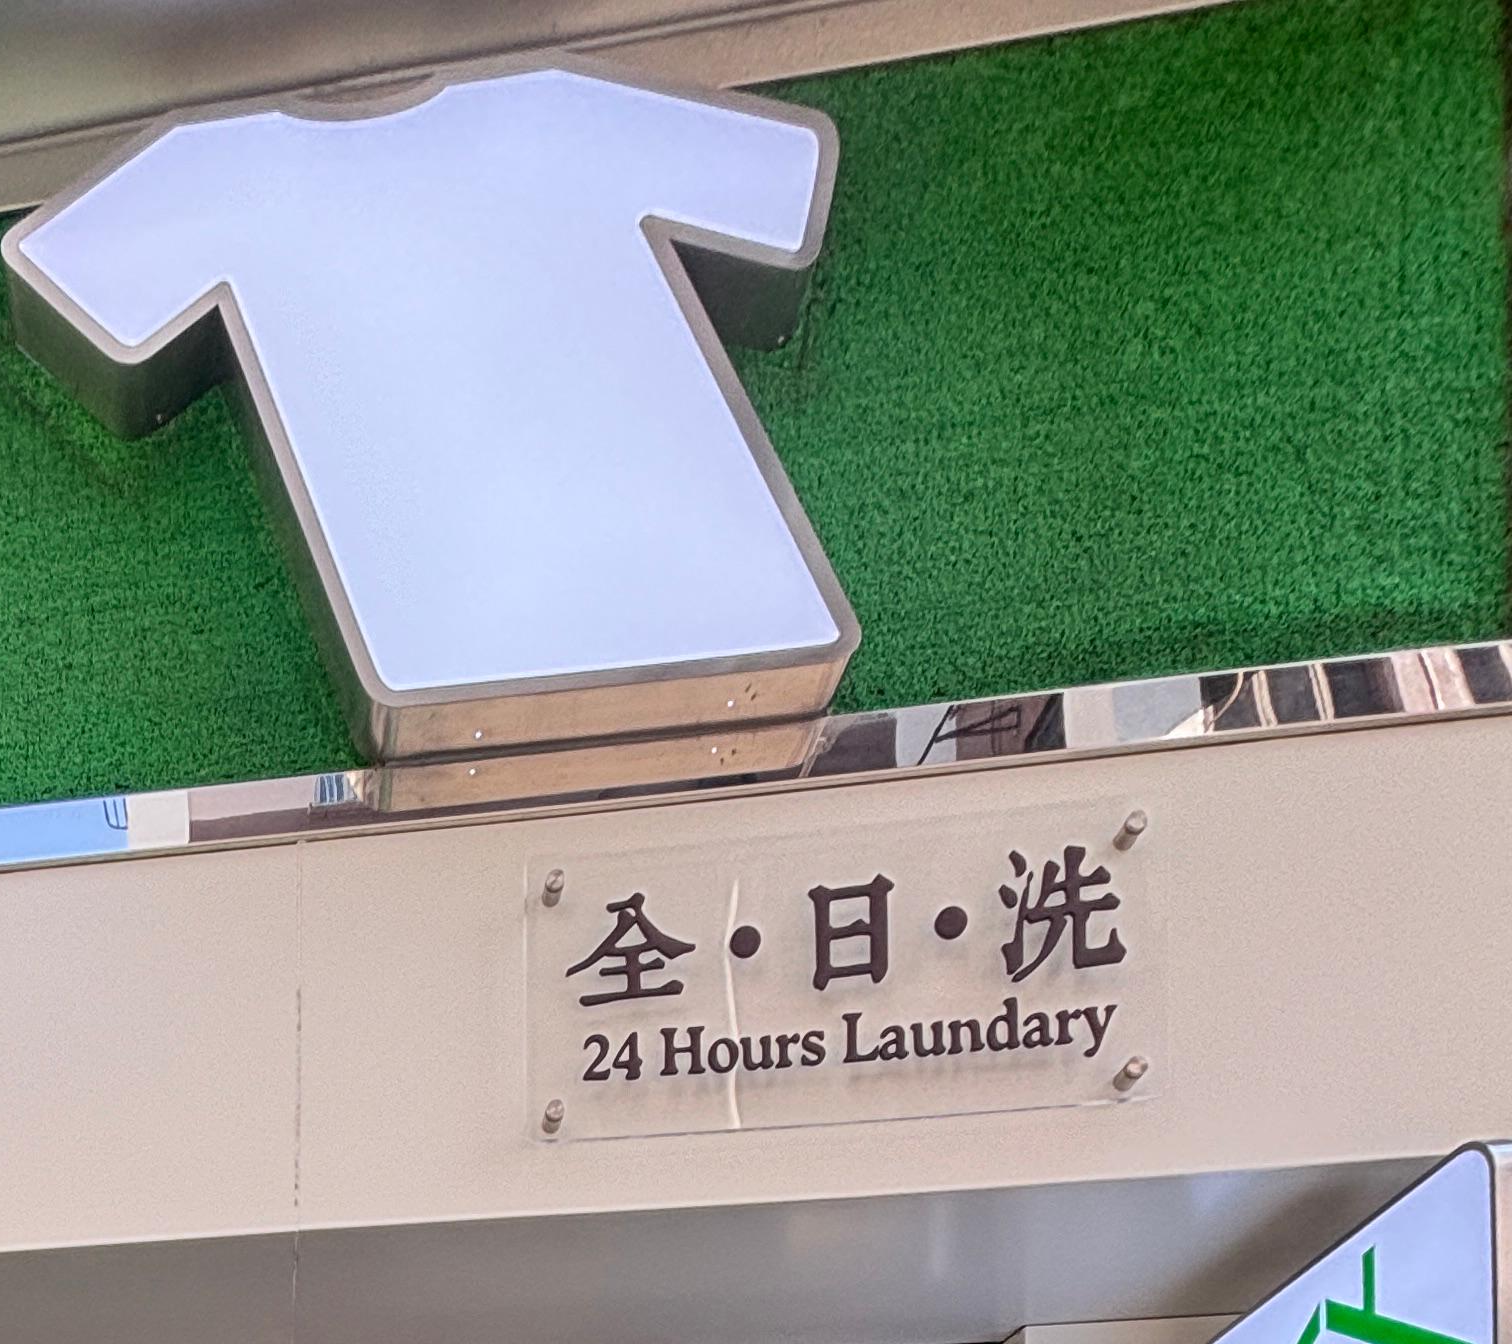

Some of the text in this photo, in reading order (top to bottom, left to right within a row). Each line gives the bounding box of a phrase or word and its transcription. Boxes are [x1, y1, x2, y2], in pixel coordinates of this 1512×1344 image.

[581, 997, 1118, 1082] 24 Hours Laundary
